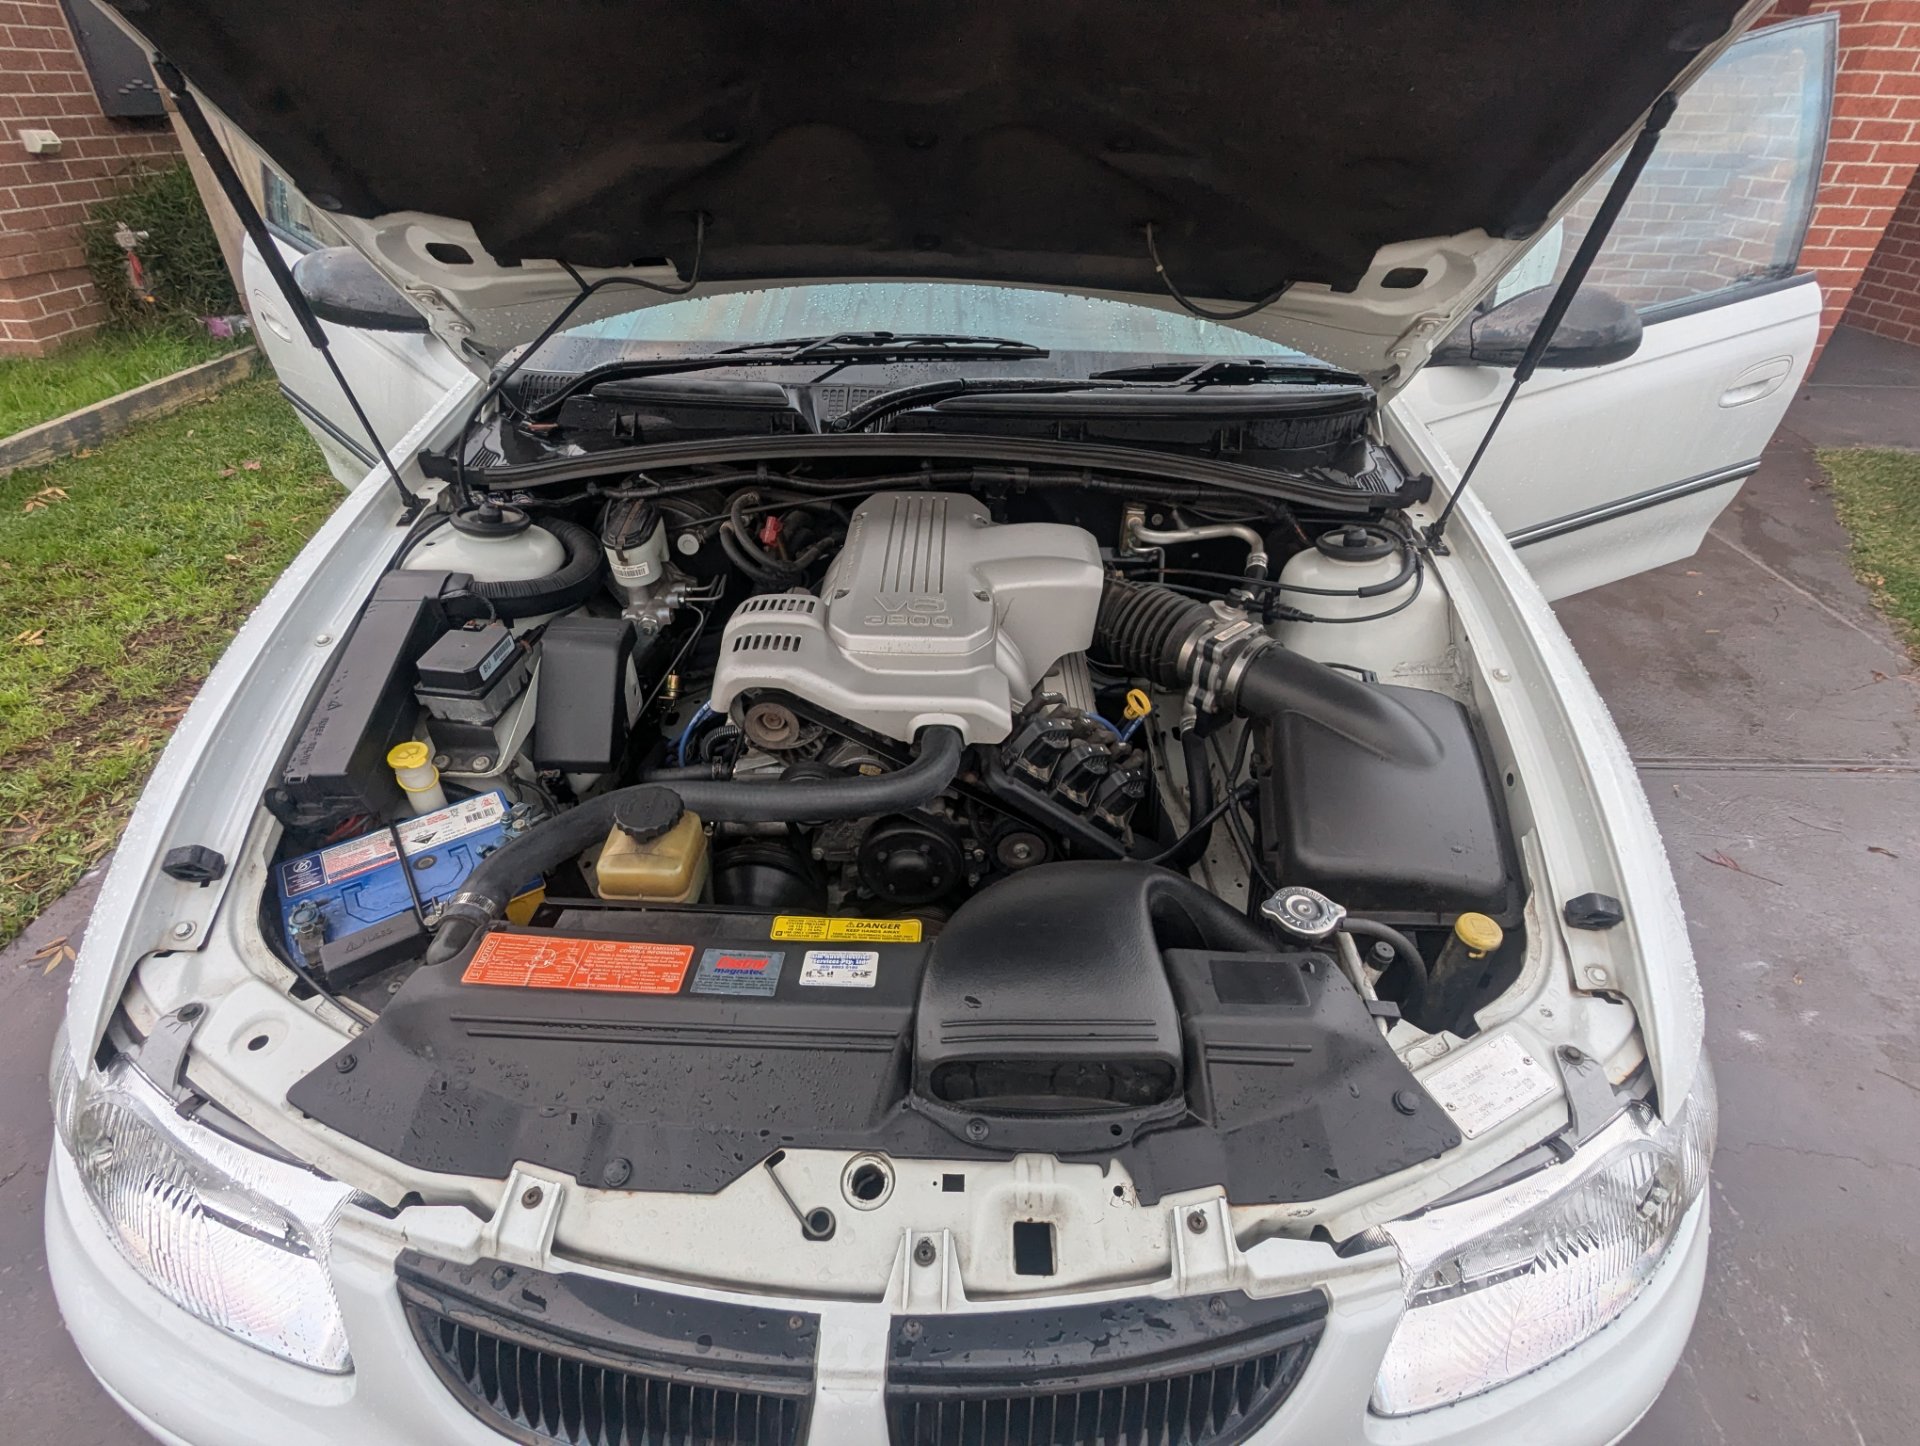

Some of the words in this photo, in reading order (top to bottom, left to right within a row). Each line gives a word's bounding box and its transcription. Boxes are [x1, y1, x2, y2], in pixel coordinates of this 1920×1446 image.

[873, 595, 946, 614] V6
[863, 615, 953, 628] 3800
[478, 939, 497, 963] NOTICE
